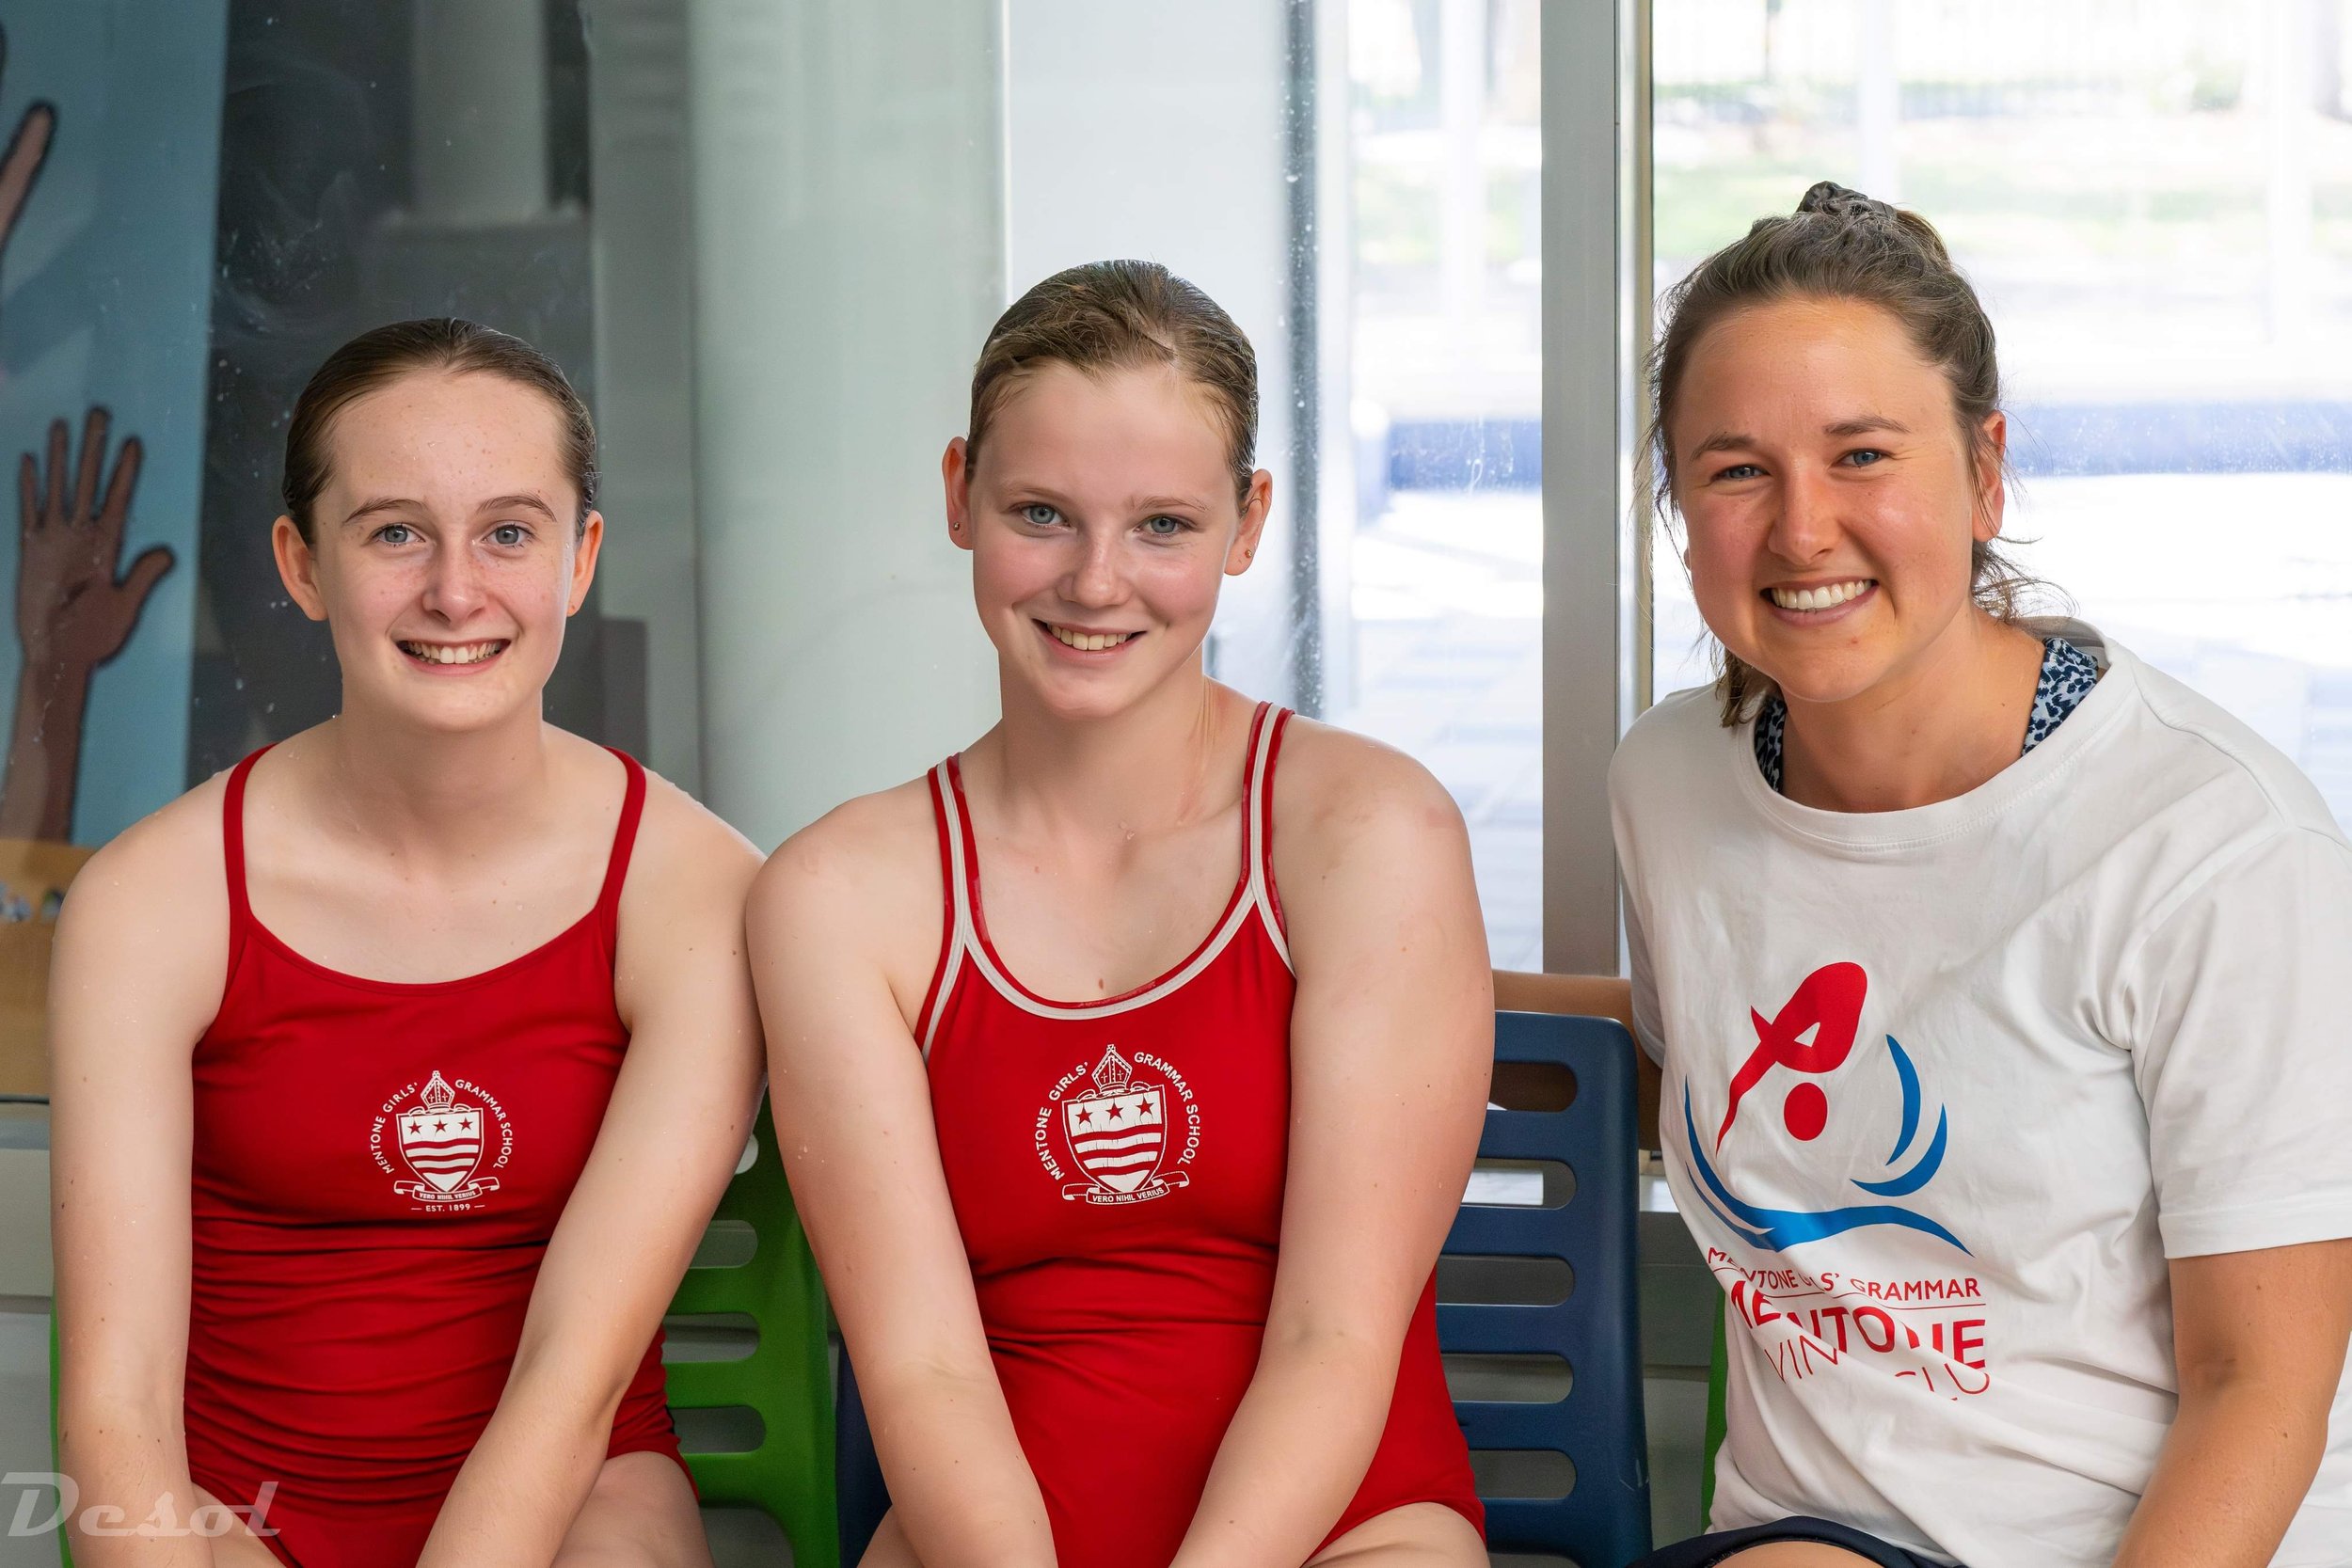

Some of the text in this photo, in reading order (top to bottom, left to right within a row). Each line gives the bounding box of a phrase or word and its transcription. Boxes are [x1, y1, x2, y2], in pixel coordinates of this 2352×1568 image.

[370, 1079, 513, 1175] MENTONE GIRLS' GRAMMAR SCHOOL
[1034, 1052, 1201, 1180] MENTONE GIRLS' GRAMMAR SCHOOL
[1092, 1187, 1165, 1203] VERO NIHIL VERIUS
[449, 1203, 470, 1212] 1899
[1851, 1277, 1981, 1301] GRAMMAR
